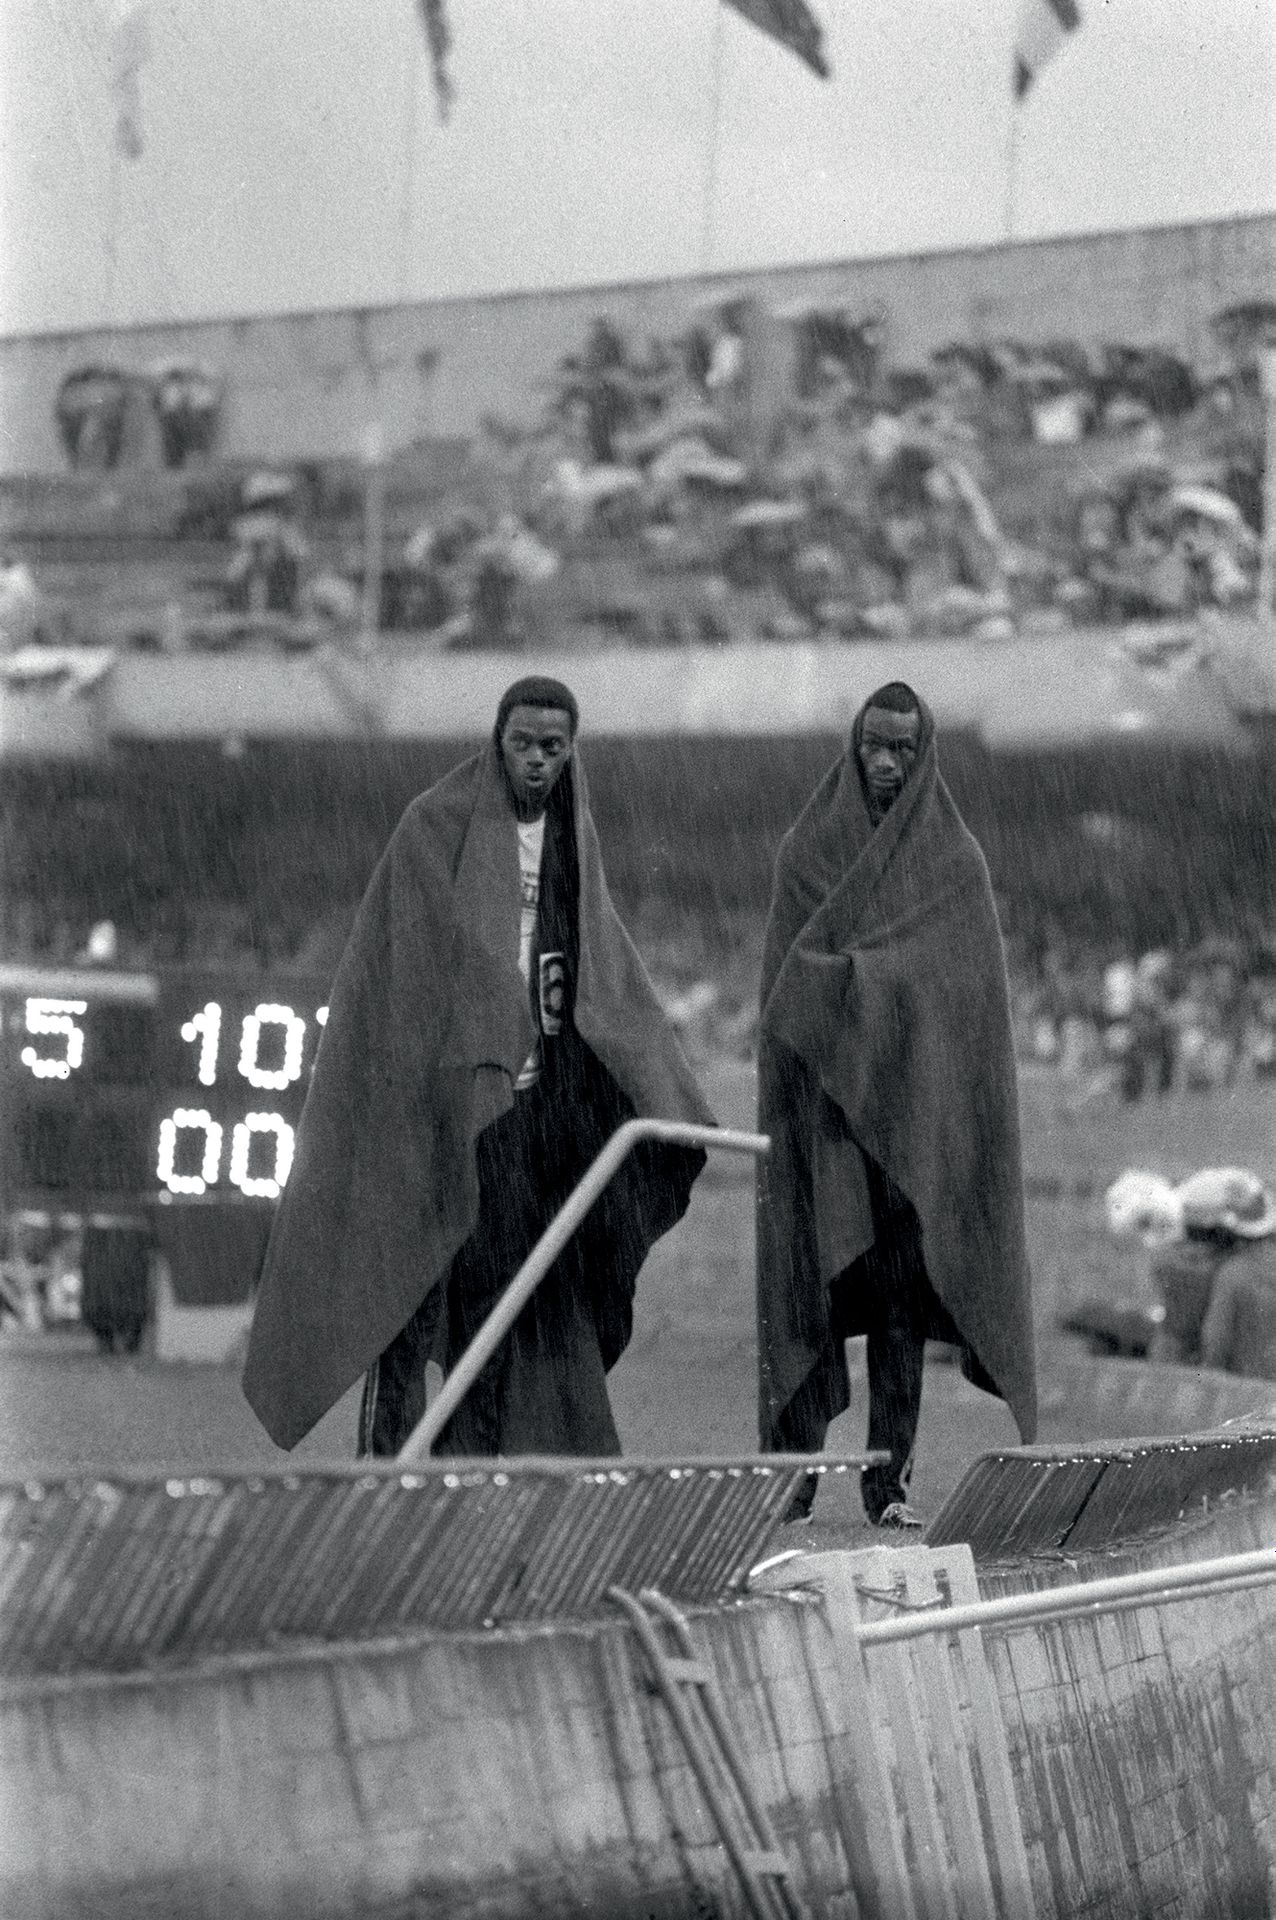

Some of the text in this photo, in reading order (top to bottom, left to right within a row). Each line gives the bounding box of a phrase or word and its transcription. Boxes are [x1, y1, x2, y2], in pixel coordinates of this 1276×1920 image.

[21, 997, 329, 1090] 5 10
[157, 1108, 295, 1198] 00
